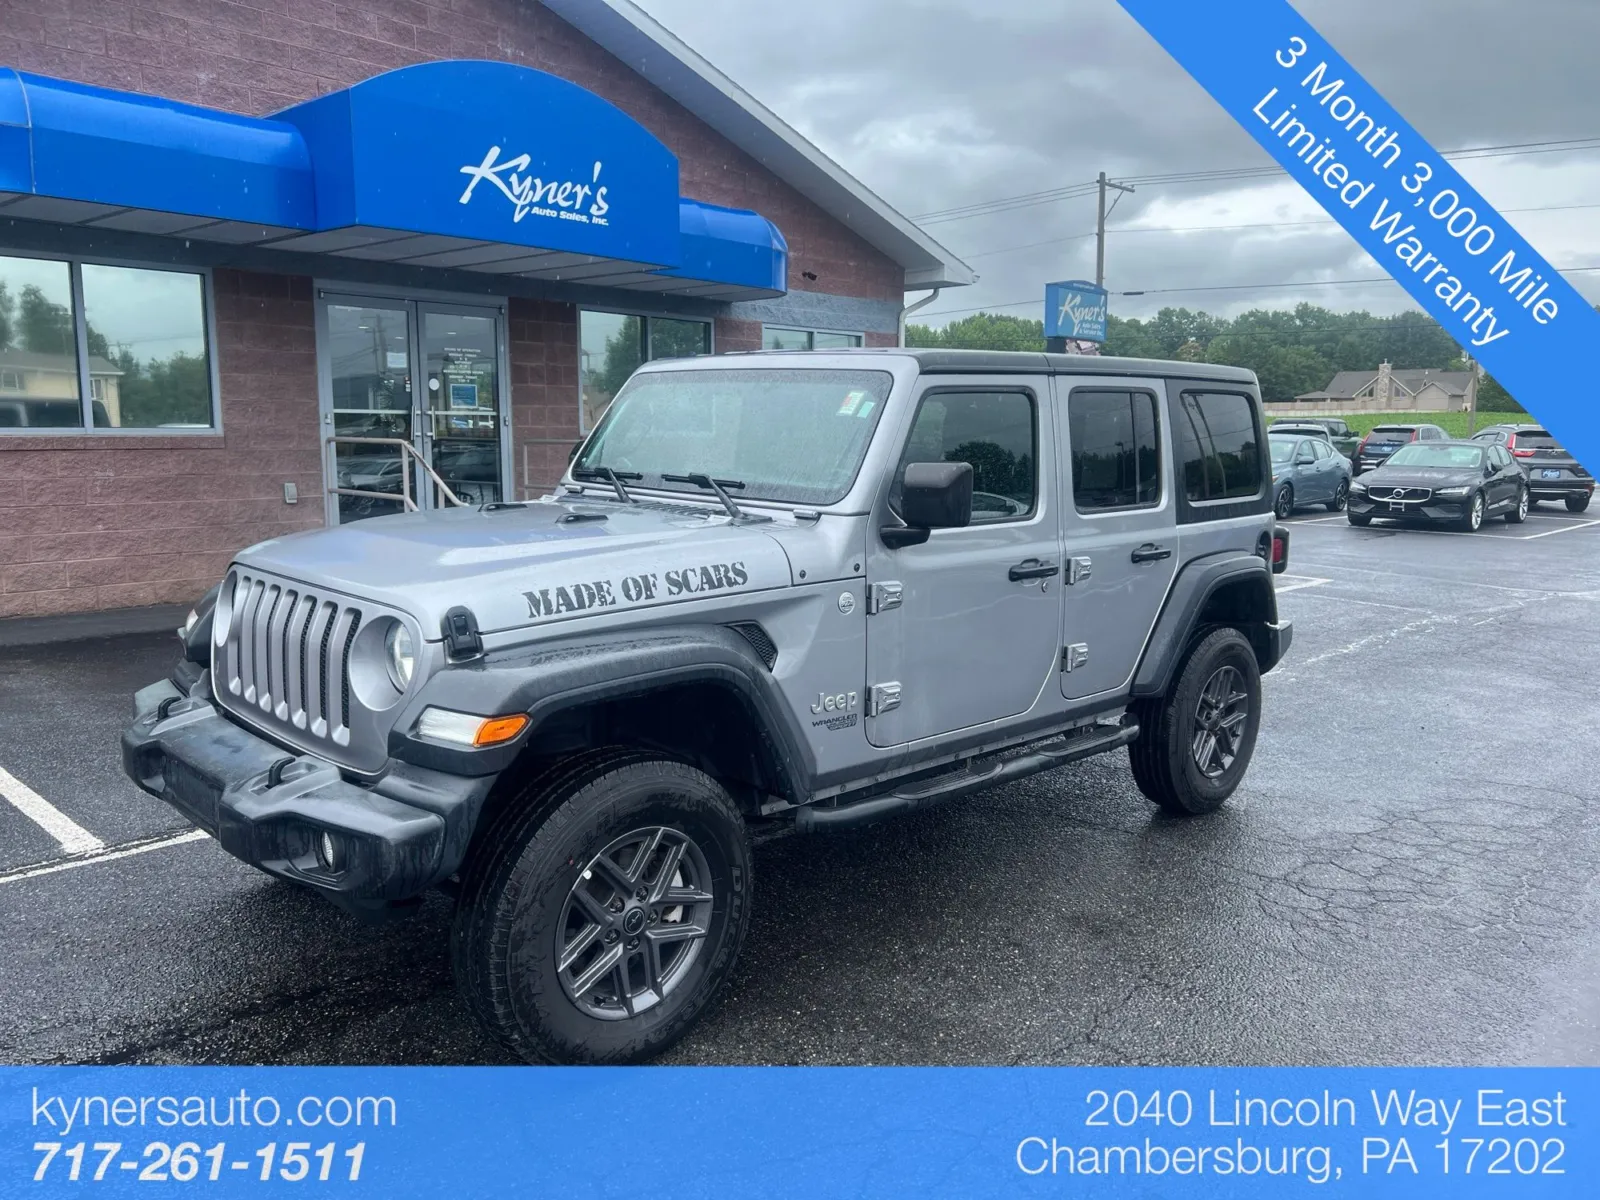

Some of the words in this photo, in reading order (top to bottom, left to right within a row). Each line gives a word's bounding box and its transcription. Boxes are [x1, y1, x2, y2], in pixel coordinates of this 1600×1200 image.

[459, 145, 609, 223] Kyner's
[531, 206, 558, 218] Auto
[559, 210, 590, 224] Sales,
[591, 215, 609, 226] Inc.
[1058, 292, 1105, 336] Kyner's
[522, 579, 617, 619] MADE
[621, 573, 658, 603] OF
[664, 560, 749, 597] SCARS
[810, 691, 858, 715] Jeep
[811, 713, 858, 727] WRANGLER
